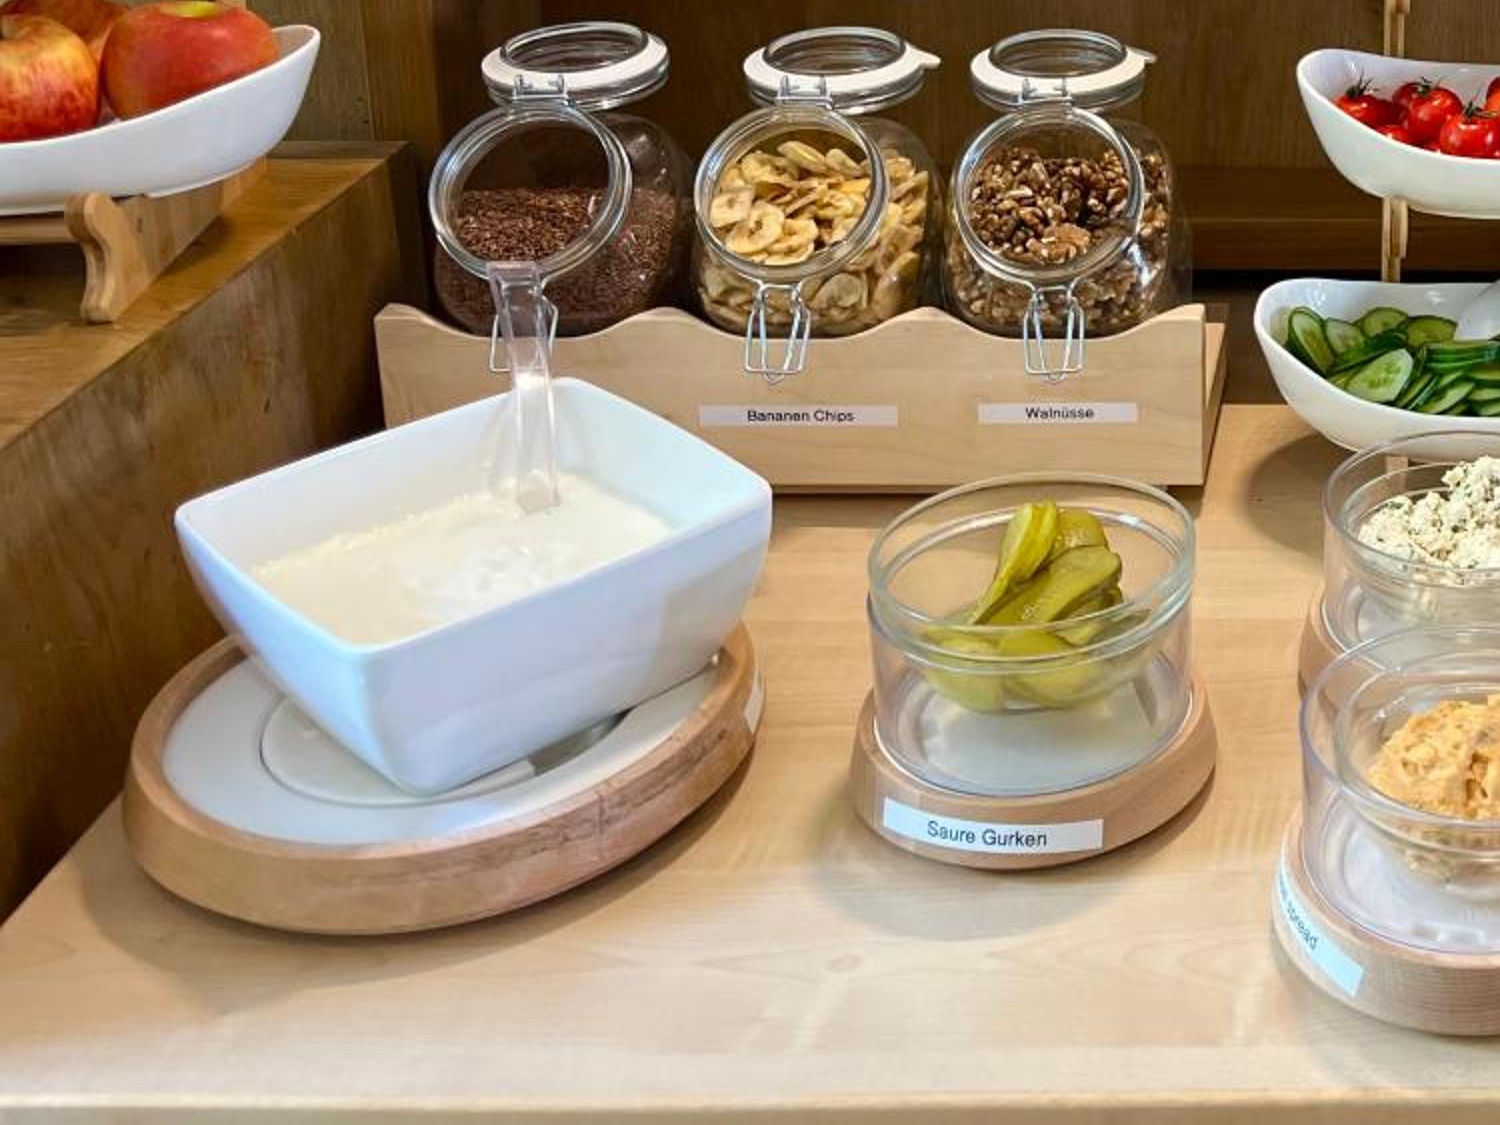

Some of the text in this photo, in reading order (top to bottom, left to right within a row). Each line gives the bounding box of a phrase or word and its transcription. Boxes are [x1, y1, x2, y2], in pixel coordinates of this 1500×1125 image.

[746, 409, 855, 425] Bananen Chips
[1025, 405, 1095, 420] Walnüsse
[927, 820, 1048, 847] Saure Gurken
